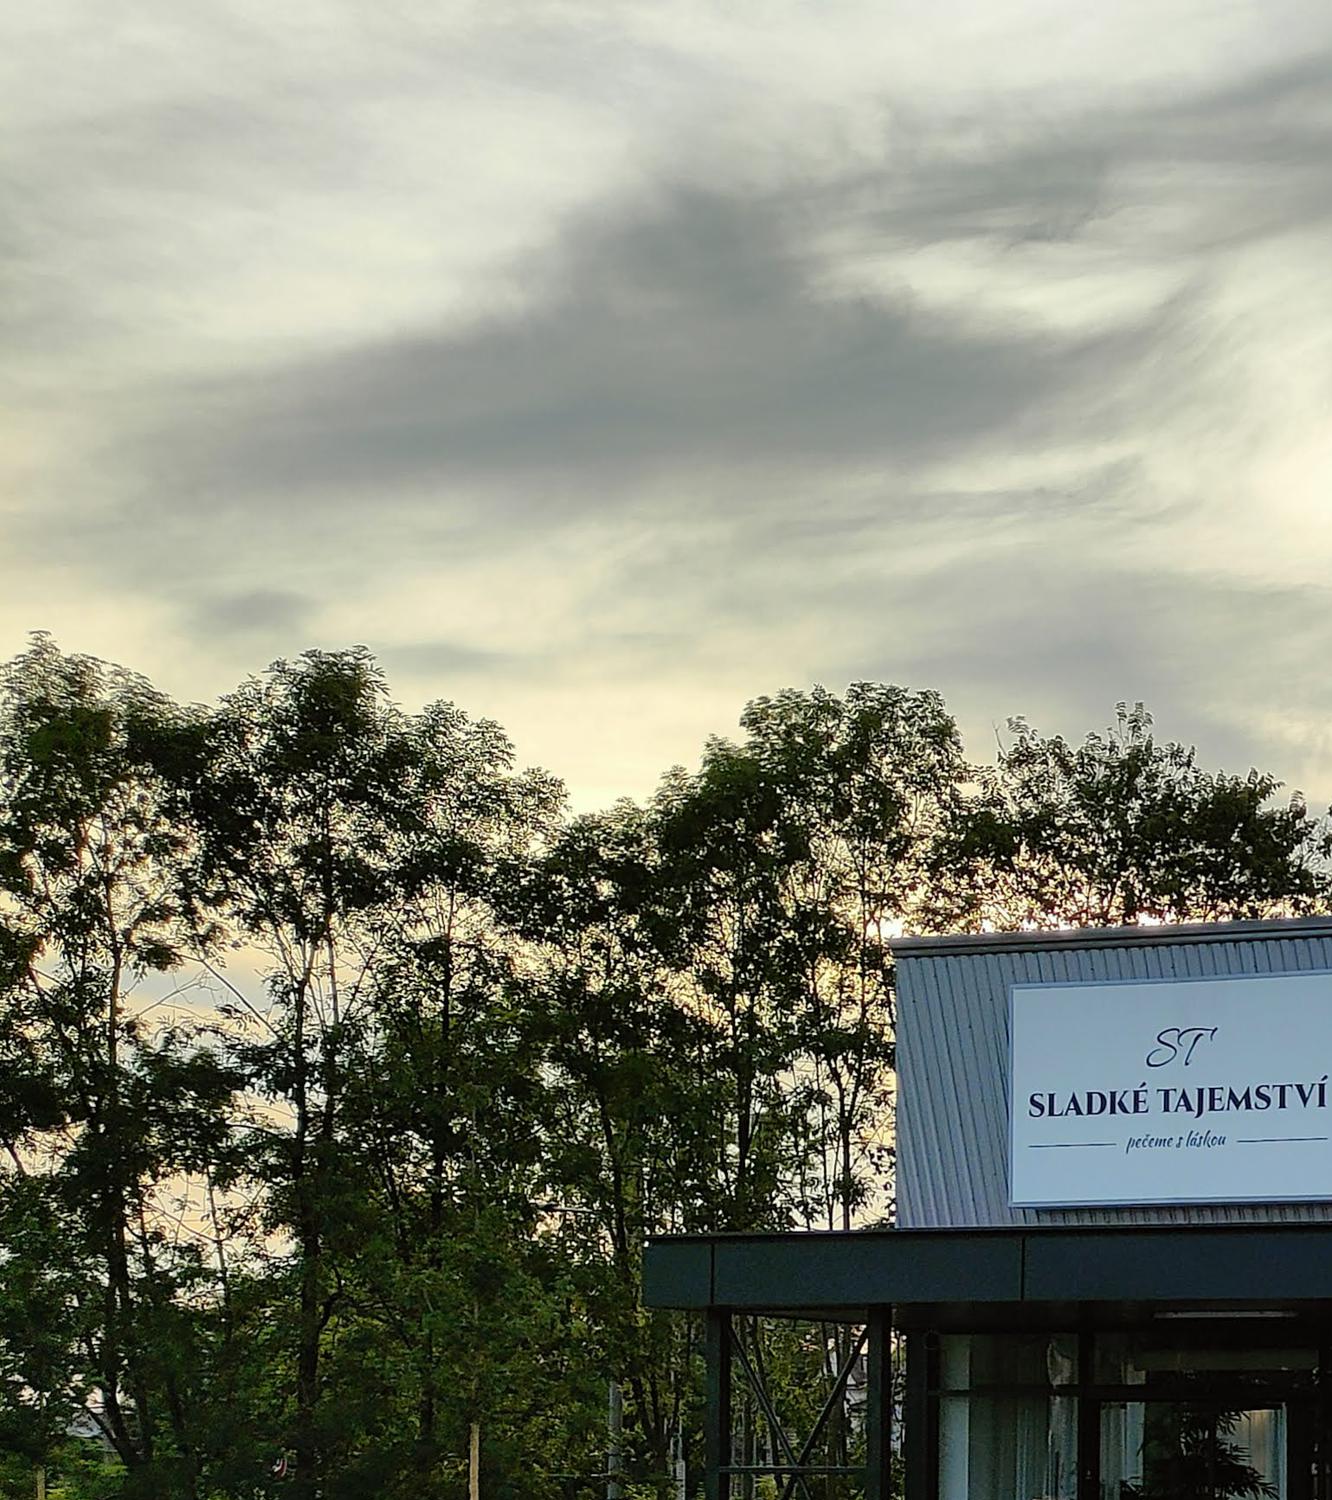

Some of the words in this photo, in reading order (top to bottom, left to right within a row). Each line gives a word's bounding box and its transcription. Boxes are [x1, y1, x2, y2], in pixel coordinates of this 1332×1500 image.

[1028, 1081, 1149, 1118] SLADKÉ
[1157, 1074, 1329, 1119] TAJEMSTVÍ
[1125, 1133, 1175, 1154] pečeme
[1175, 1135, 1183, 1149] s
[1185, 1130, 1227, 1148] láskou
